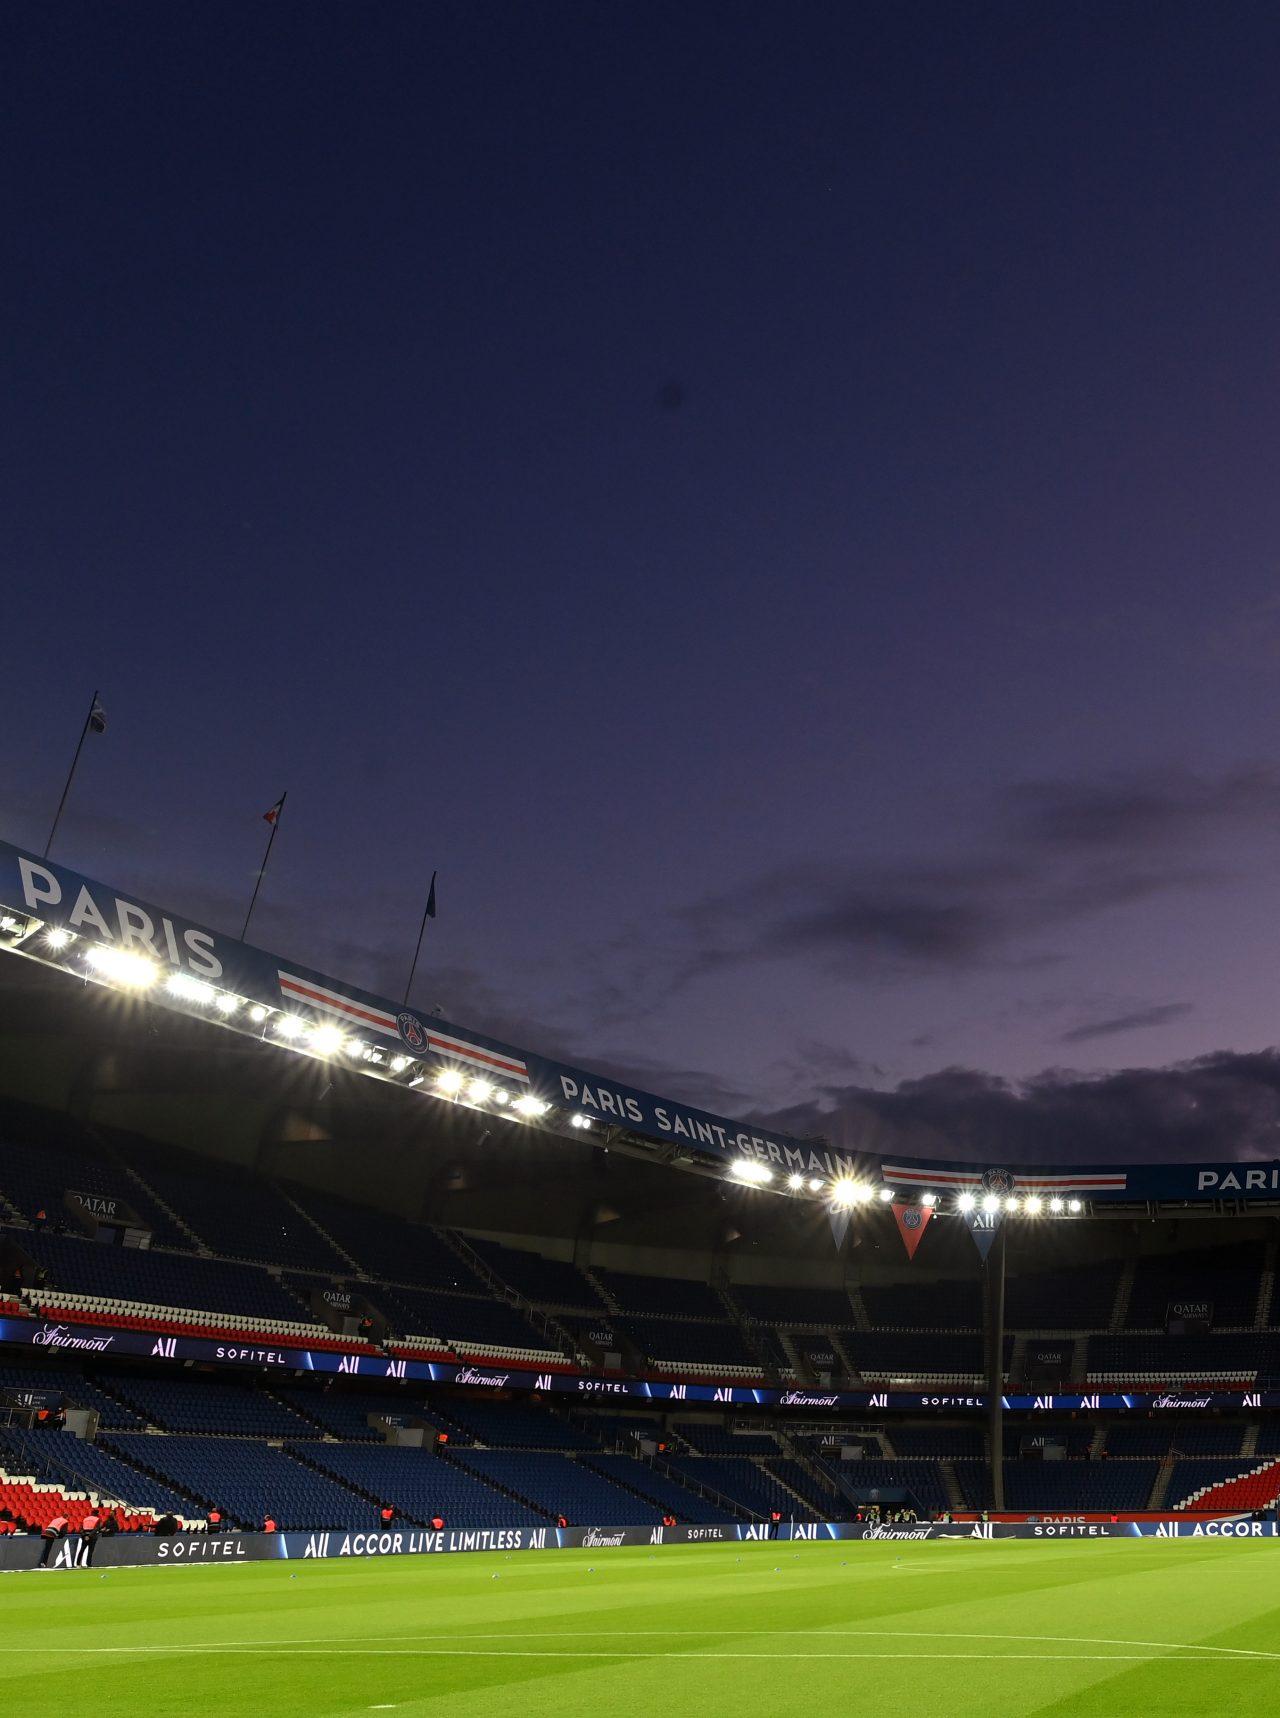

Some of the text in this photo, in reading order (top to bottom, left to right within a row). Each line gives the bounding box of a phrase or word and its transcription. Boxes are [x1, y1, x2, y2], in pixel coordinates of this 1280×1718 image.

[18, 856, 223, 977] PARIS
[560, 1075, 853, 1174] PARIS SAINT-GERMAIN
[322, 1291, 351, 1304] QATAR
[1174, 1304, 1208, 1315] QATAR
[33, 1324, 115, 1352] Fairmont
[589, 1332, 613, 1341] QATAR
[217, 1348, 284, 1363] SOFITEL
[810, 1353, 834, 1361] QATAR
[1037, 1353, 1062, 1361] QATAR
[455, 1366, 510, 1387] Fairmont
[579, 1382, 628, 1392] SOFITEL
[780, 1390, 840, 1407] Fairmont
[1153, 1394, 1212, 1408] Fairmont
[688, 1529, 722, 1538] SOFITEL
[863, 1522, 934, 1540] Fairmont
[1034, 1525, 1109, 1536] SOFITEL
[1192, 1522, 1262, 1537] ACCOR
[340, 1531, 521, 1555] ACCOR LIVE LIMITLESS
[582, 1528, 626, 1547] Fairmont
[158, 1541, 245, 1557] SOFITEL
